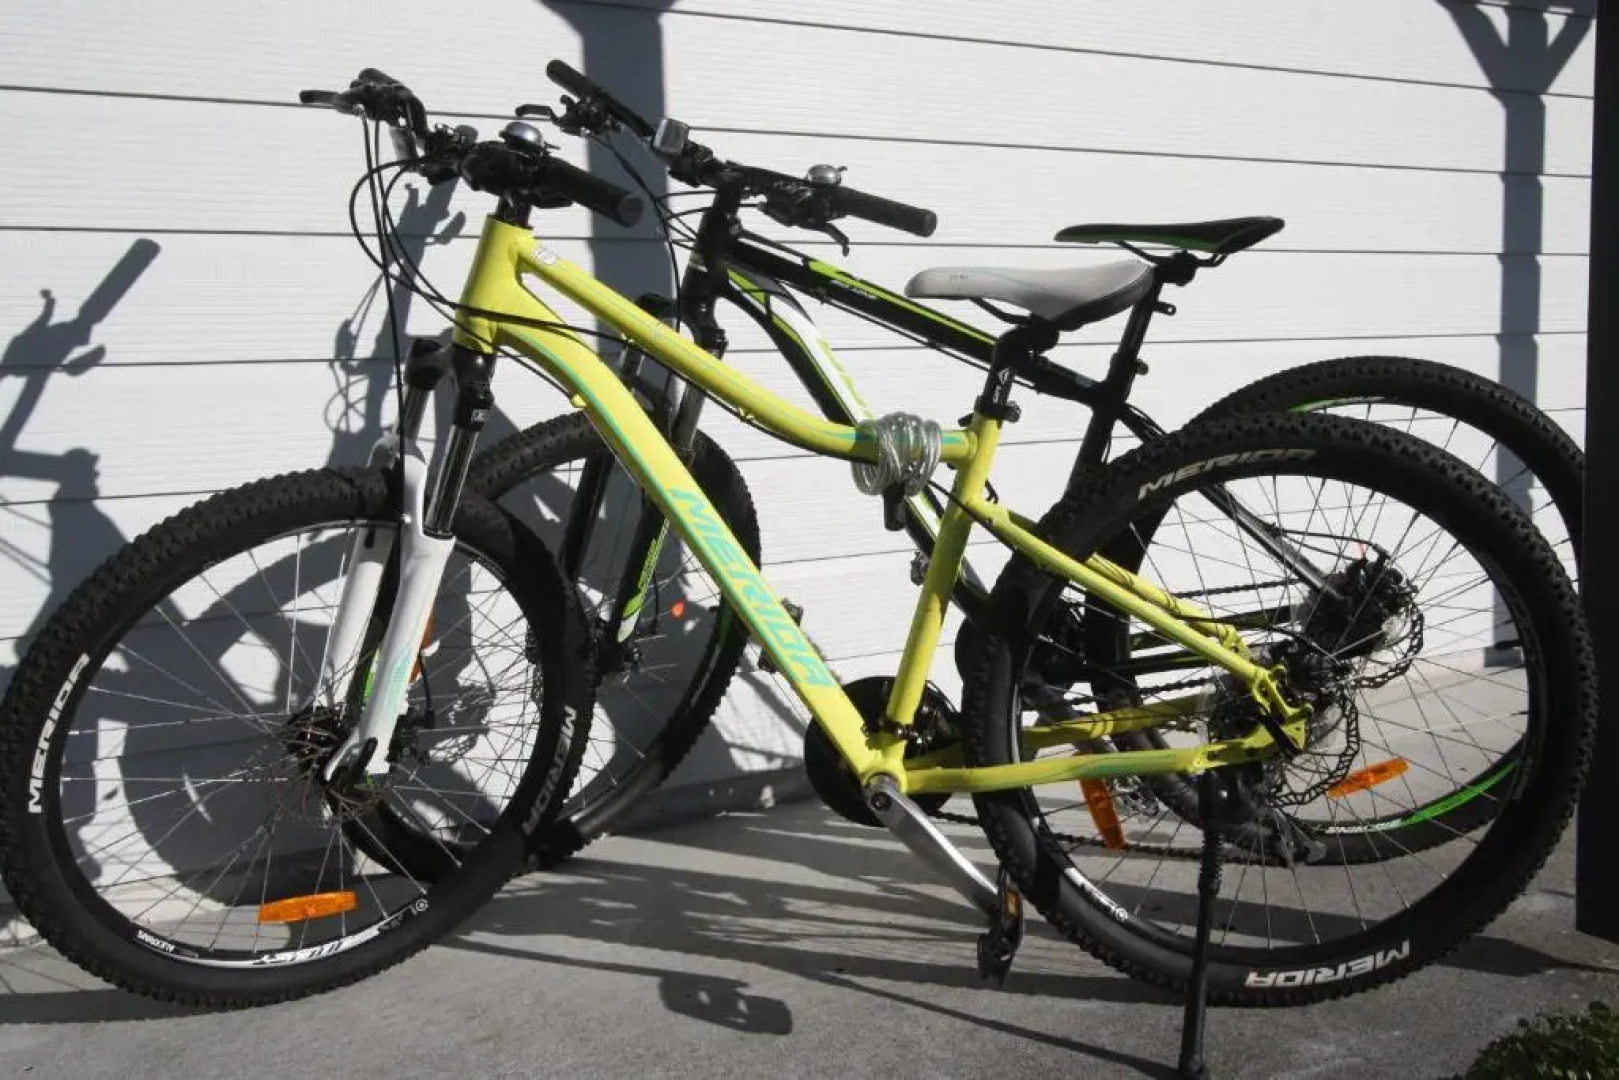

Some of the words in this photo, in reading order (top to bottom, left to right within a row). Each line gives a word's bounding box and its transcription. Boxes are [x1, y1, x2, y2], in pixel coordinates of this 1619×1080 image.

[1138, 449, 1316, 500] MERIDA
[671, 487, 835, 686] MERIDA
[28, 653, 90, 813] MERIDA
[1245, 939, 1410, 987] MERIDA
